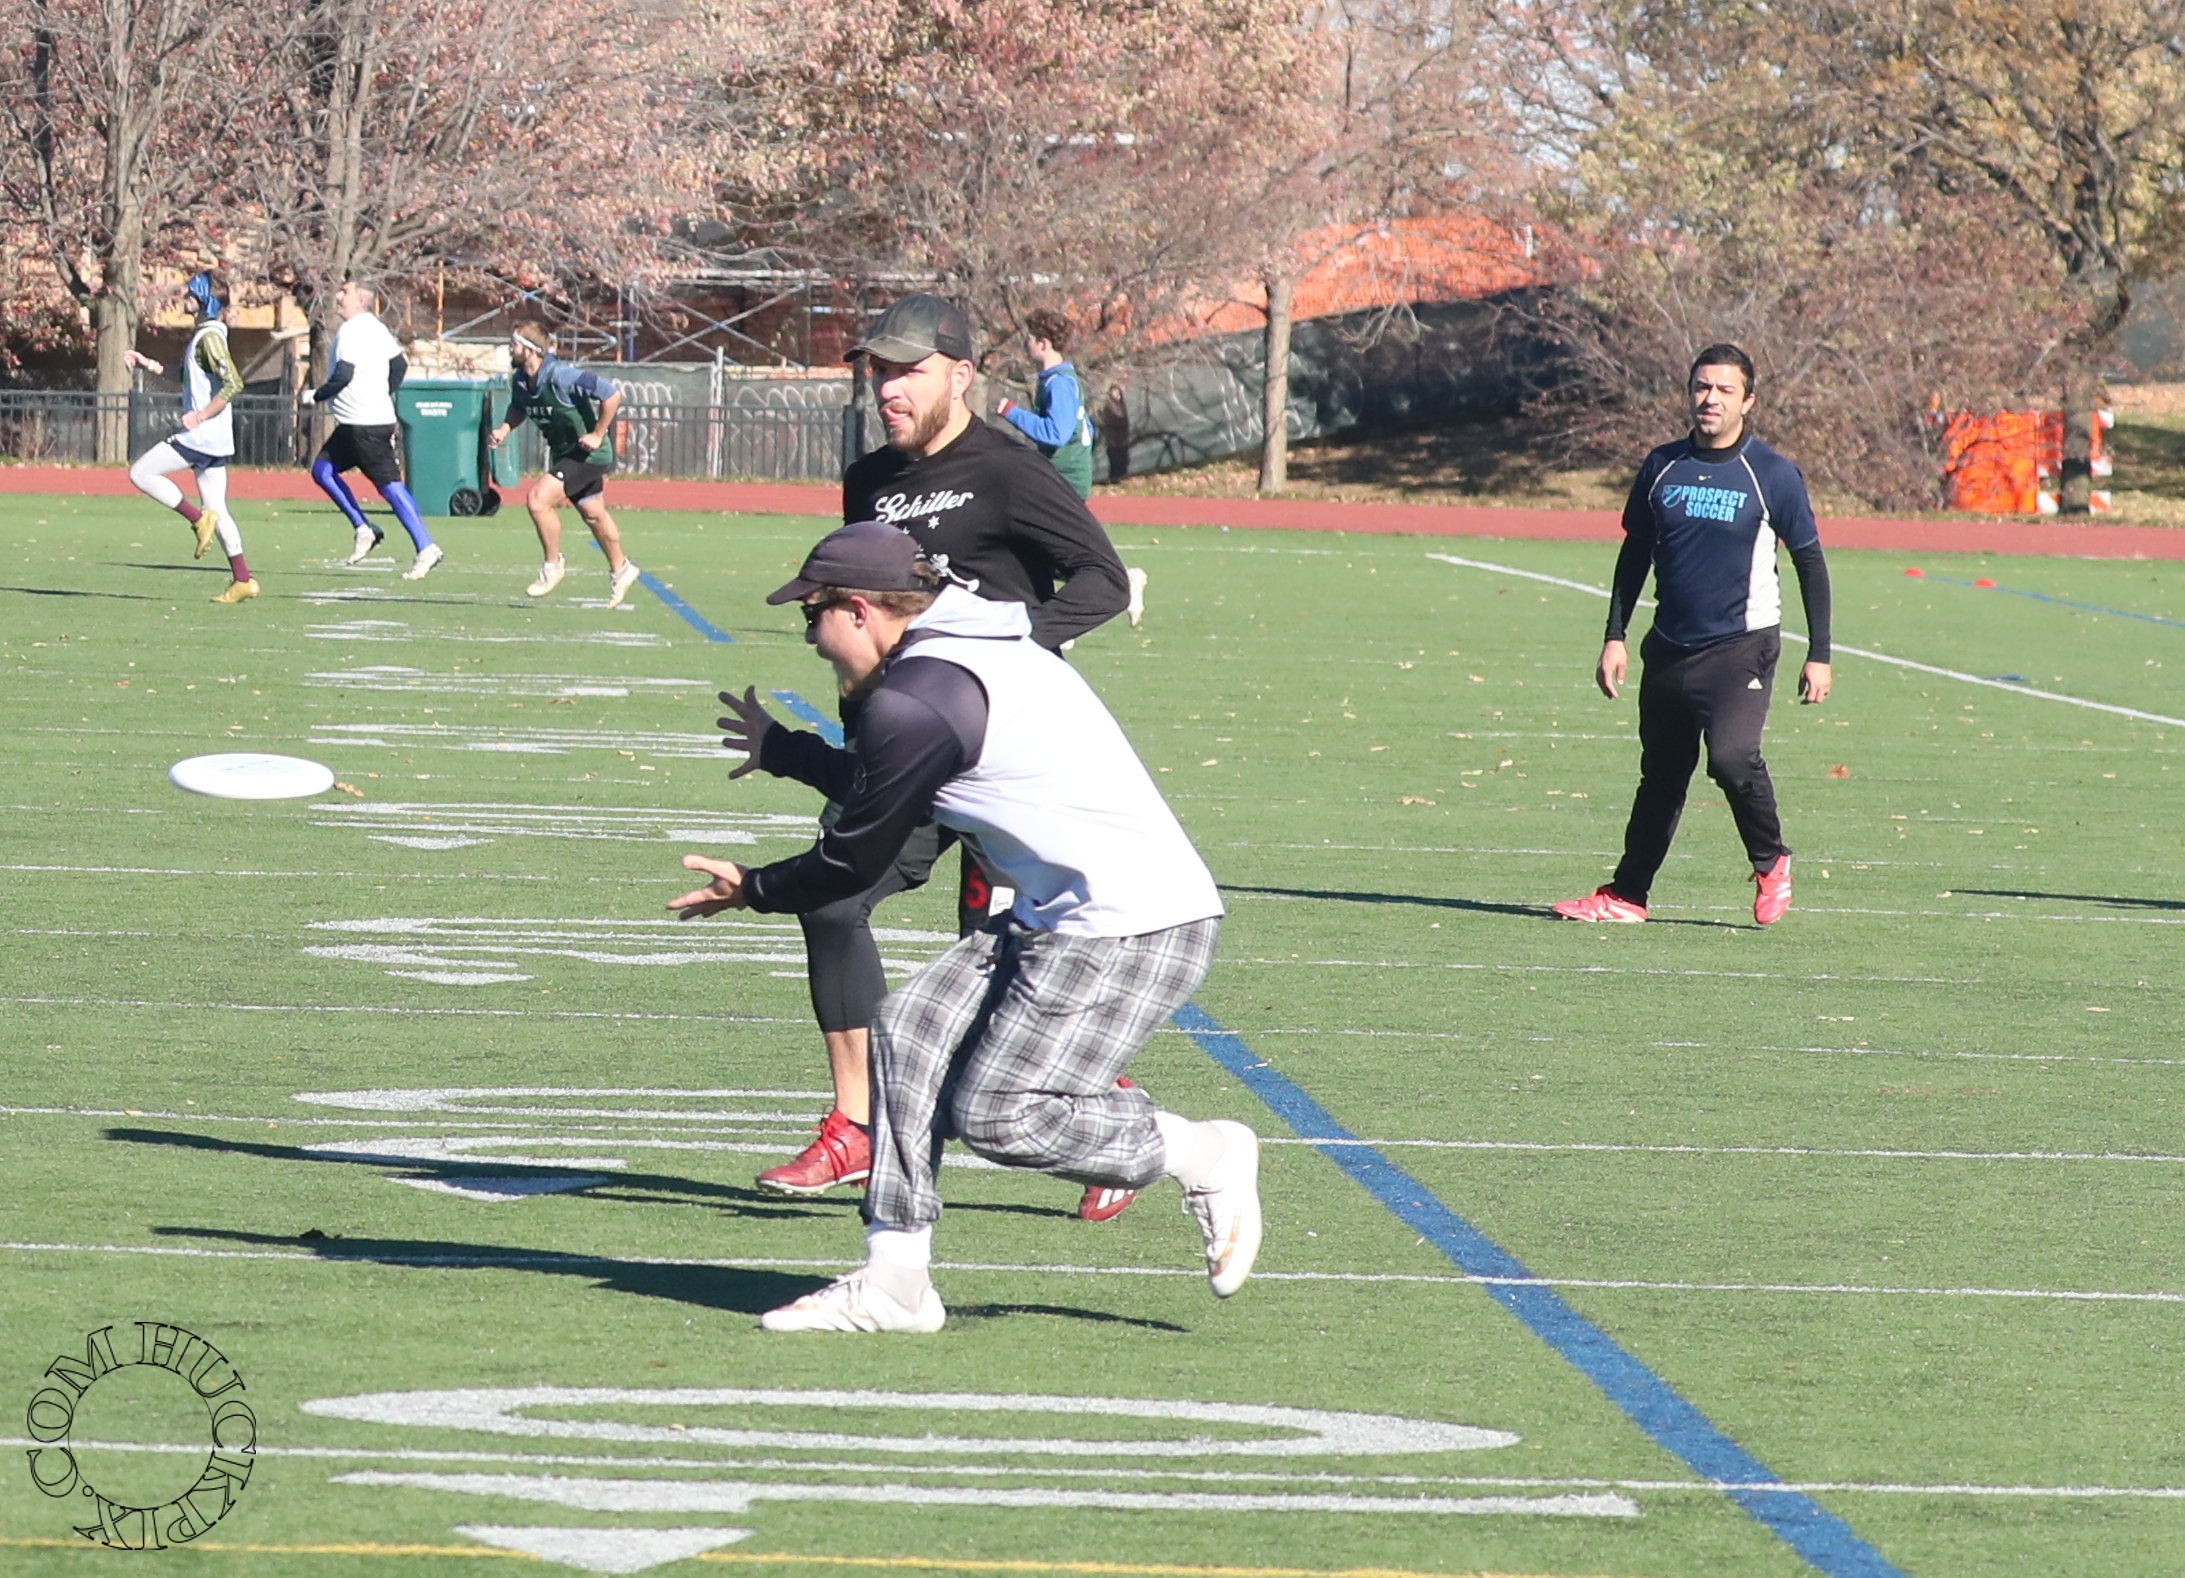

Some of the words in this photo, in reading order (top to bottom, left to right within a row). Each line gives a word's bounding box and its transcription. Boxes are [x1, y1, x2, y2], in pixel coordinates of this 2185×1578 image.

[875, 490, 974, 524] Schiller
[1681, 486, 1747, 508] PROSPECT
[1686, 502, 1735, 522] SOCCER
